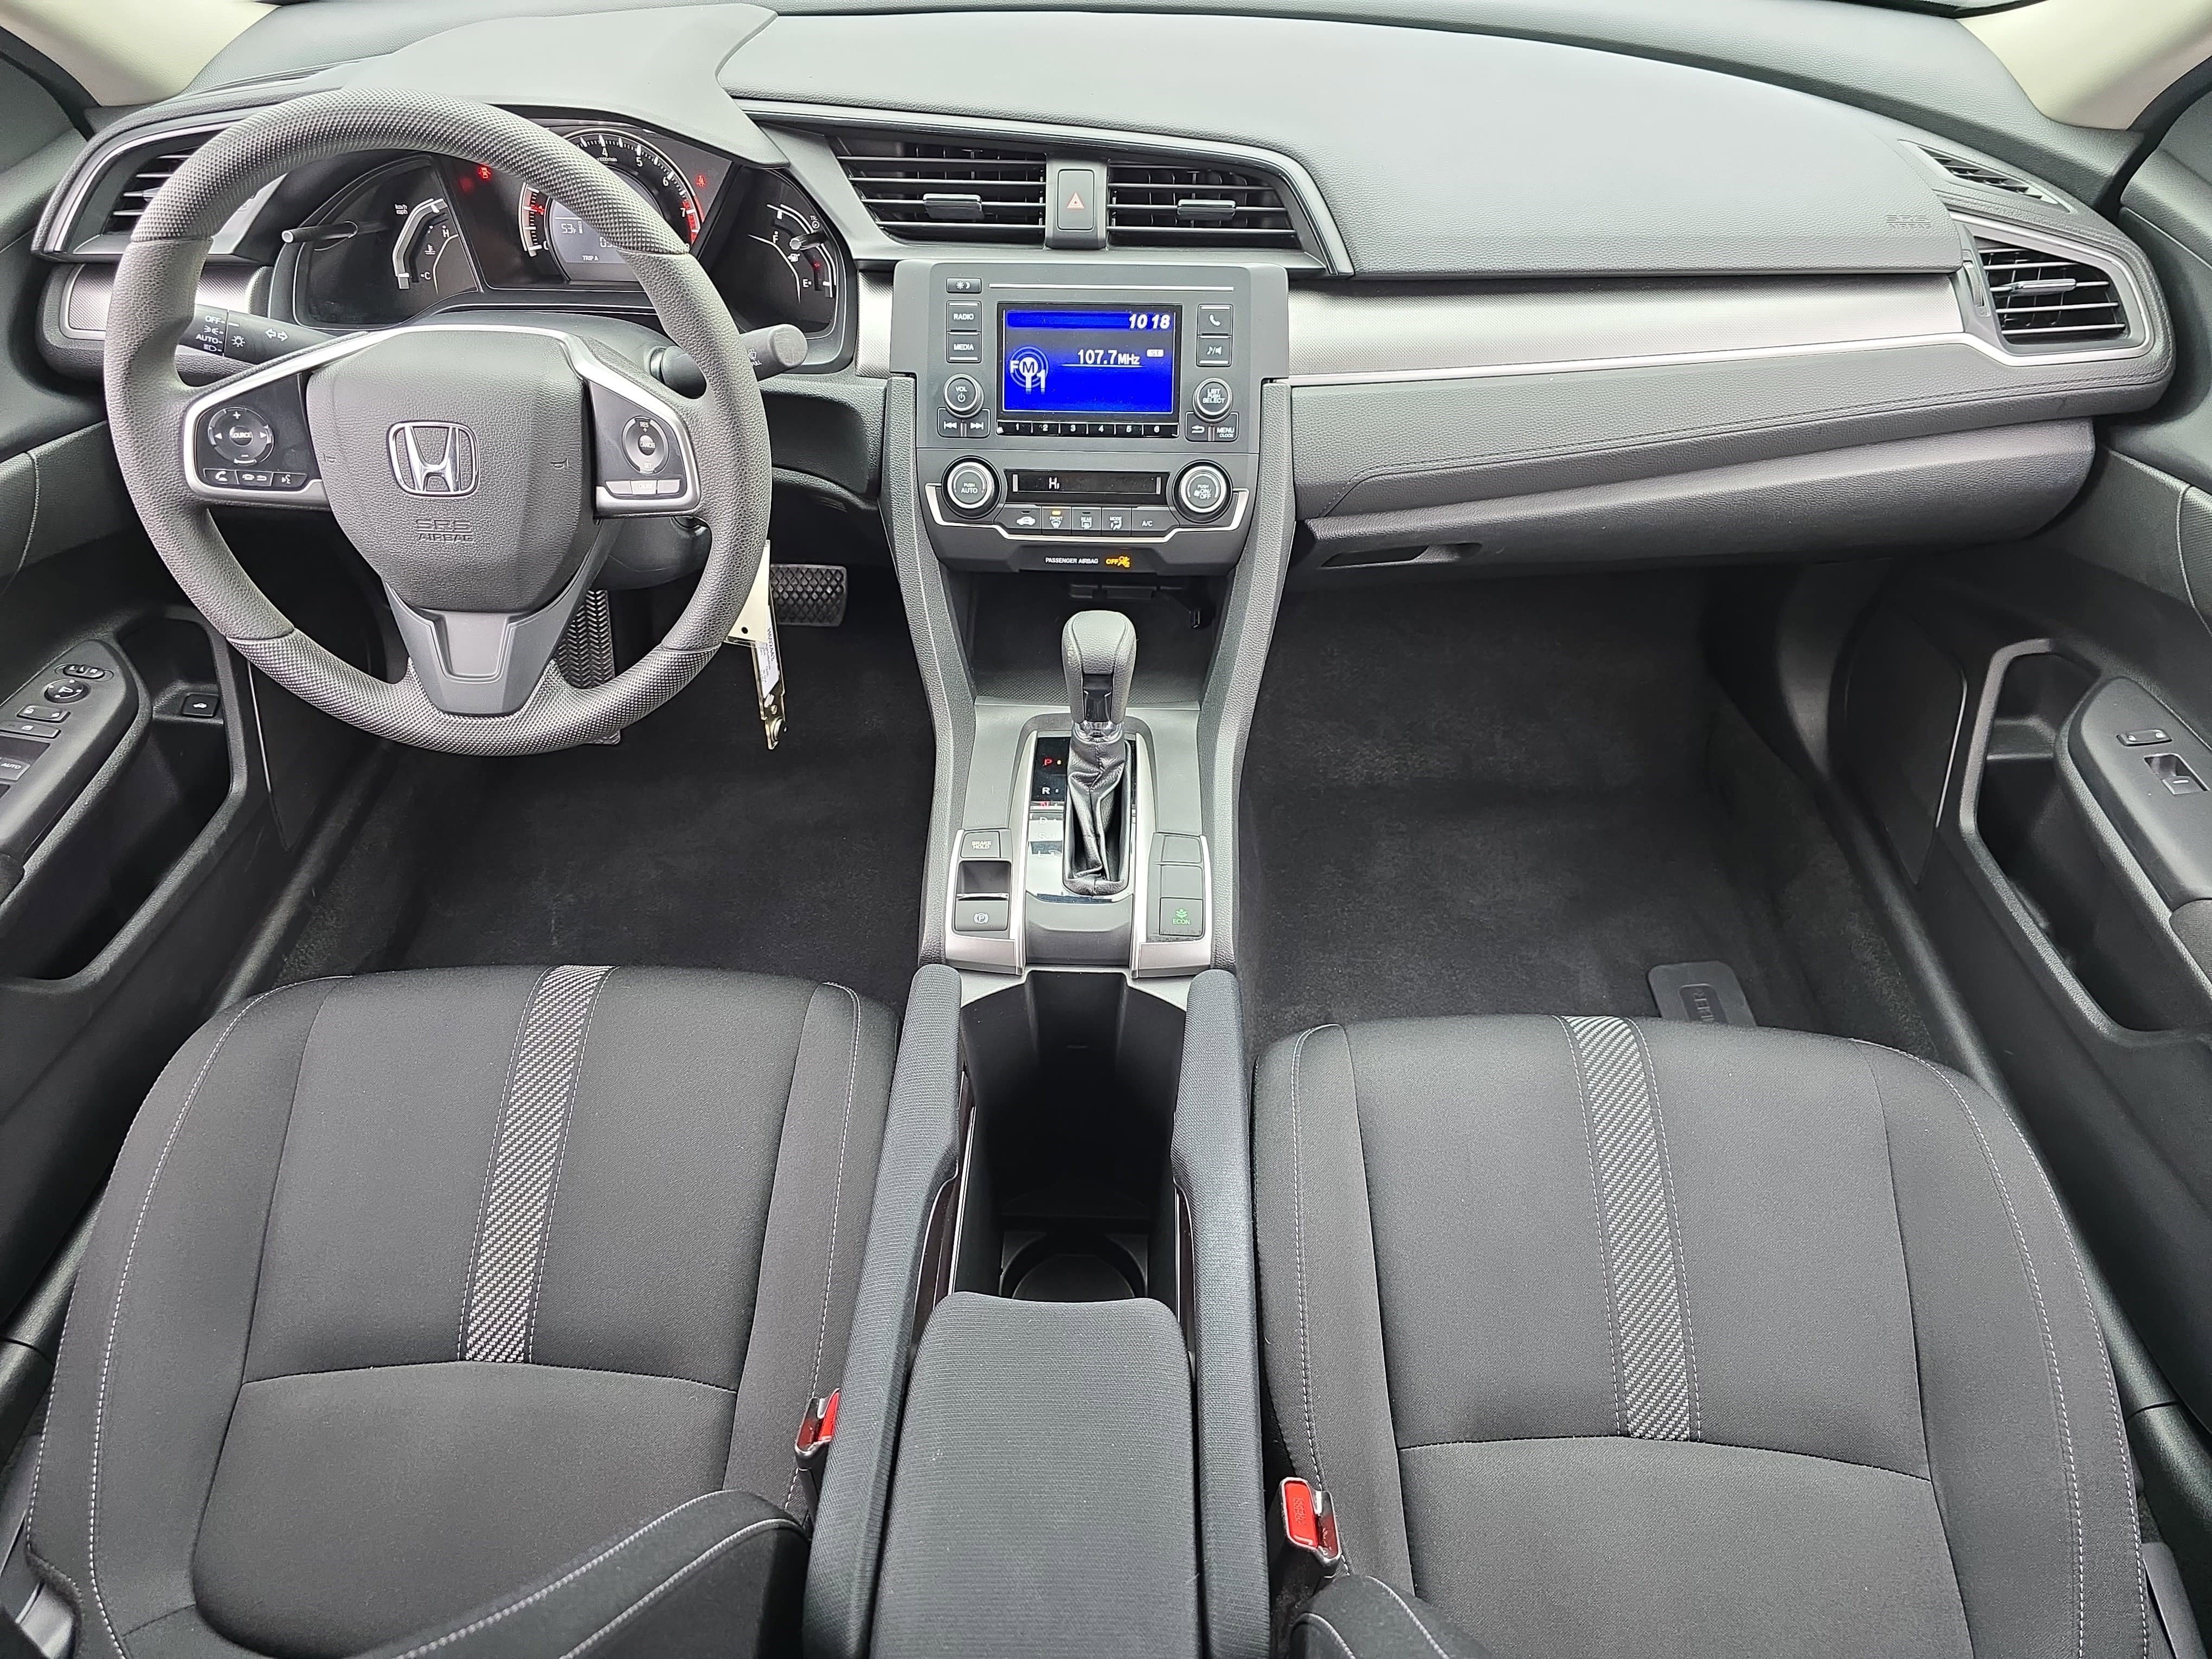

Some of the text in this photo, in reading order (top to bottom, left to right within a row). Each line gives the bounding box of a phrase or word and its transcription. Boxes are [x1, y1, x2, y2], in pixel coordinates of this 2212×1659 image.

[602, 147, 608, 157] 4
[636, 157, 643, 167] 5
[663, 177, 669, 187] 6
[680, 208, 686, 217] 7
[442, 229, 449, 237] H
[424, 272, 431, 280] C
[802, 279, 809, 287] E
[205, 315, 222, 324] OFF
[196, 333, 218, 344] AUTO
[1041, 787, 1051, 795] R
